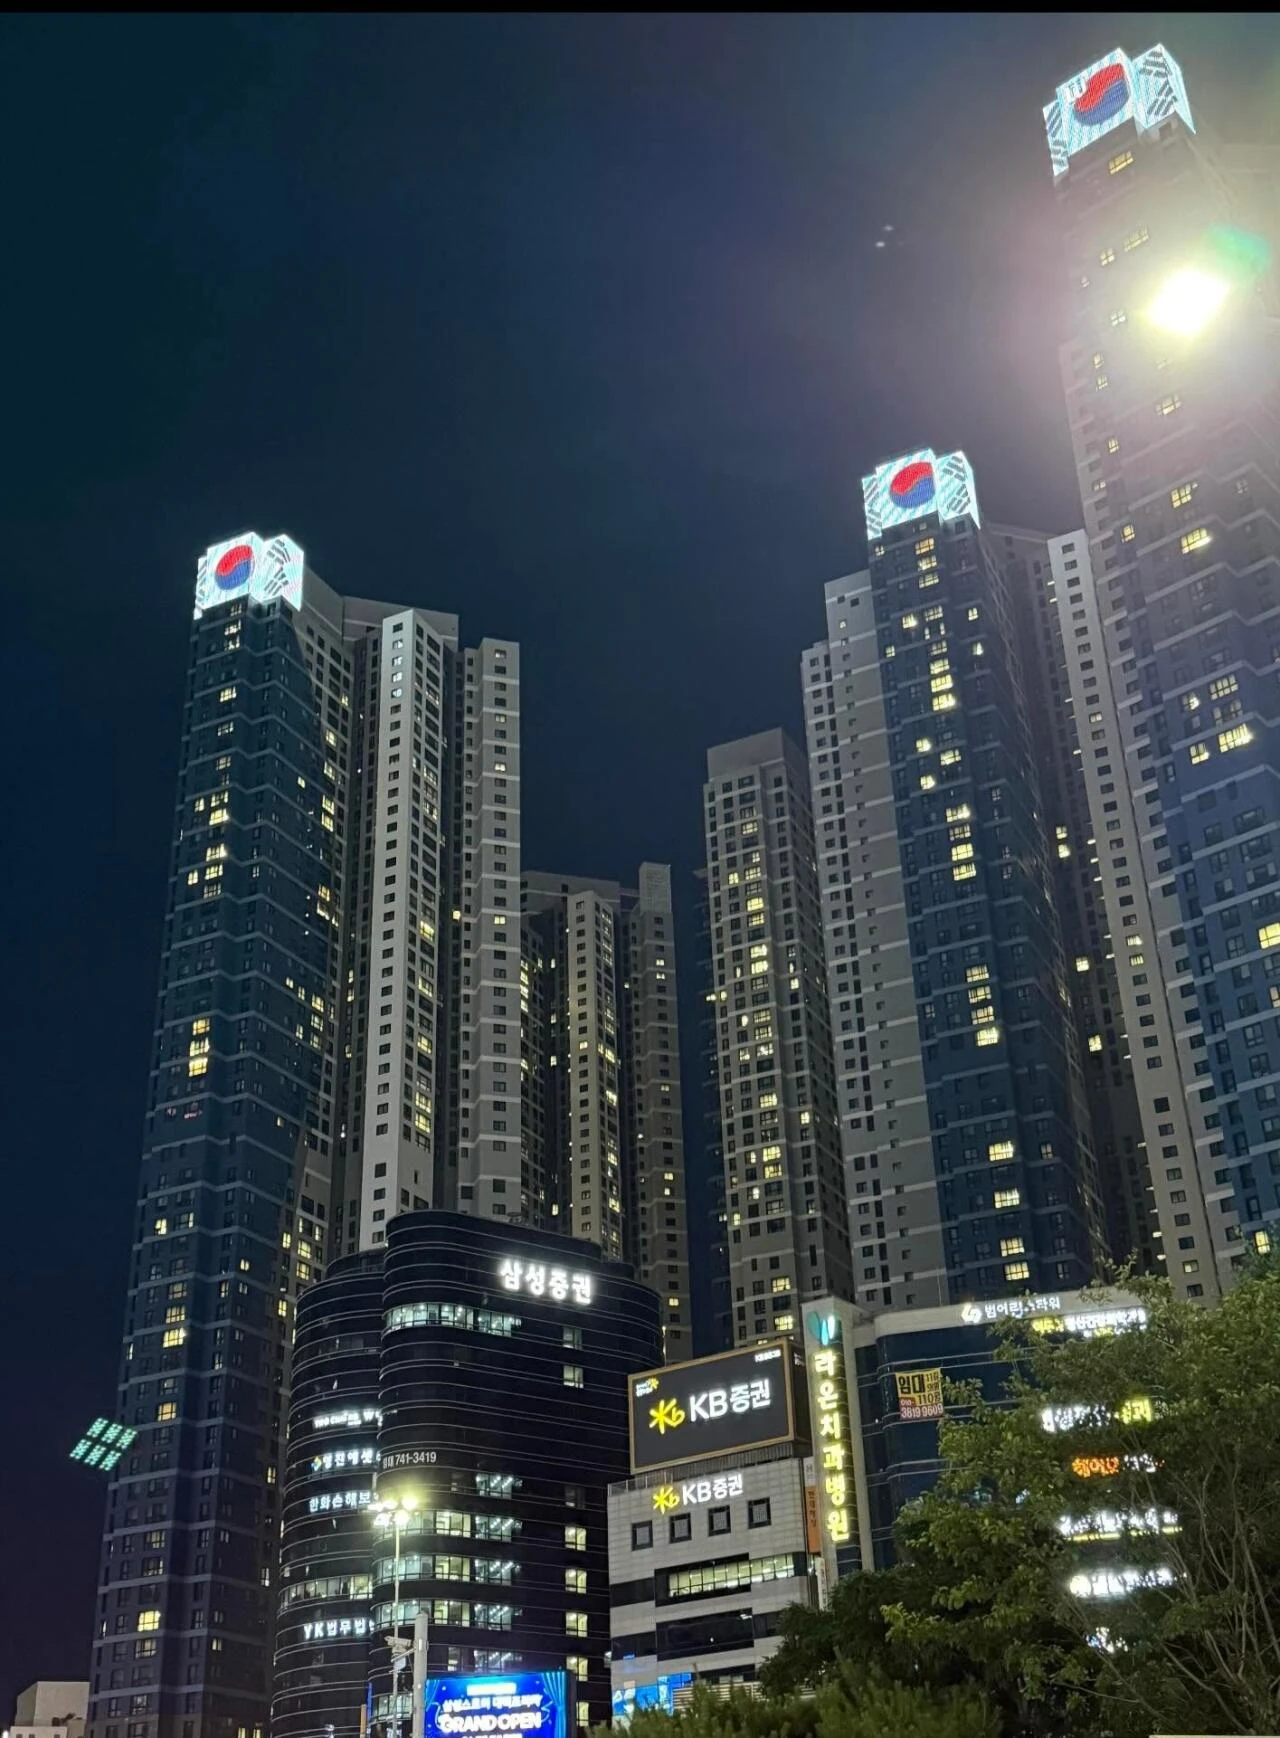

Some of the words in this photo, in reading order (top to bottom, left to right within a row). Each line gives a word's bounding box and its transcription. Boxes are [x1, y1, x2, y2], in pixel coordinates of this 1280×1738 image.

[499, 1259, 592, 1306] 삼성증권
[689, 1378, 772, 1423] KB증권
[898, 1373, 926, 1395] 임대
[395, 1451, 437, 1466] 741-3419
[814, 1350, 850, 1543] 라온치과병원
[682, 1473, 744, 1506] KB증권
[438, 1713, 497, 1734] GRAND
[497, 1711, 542, 1731] OPEN
